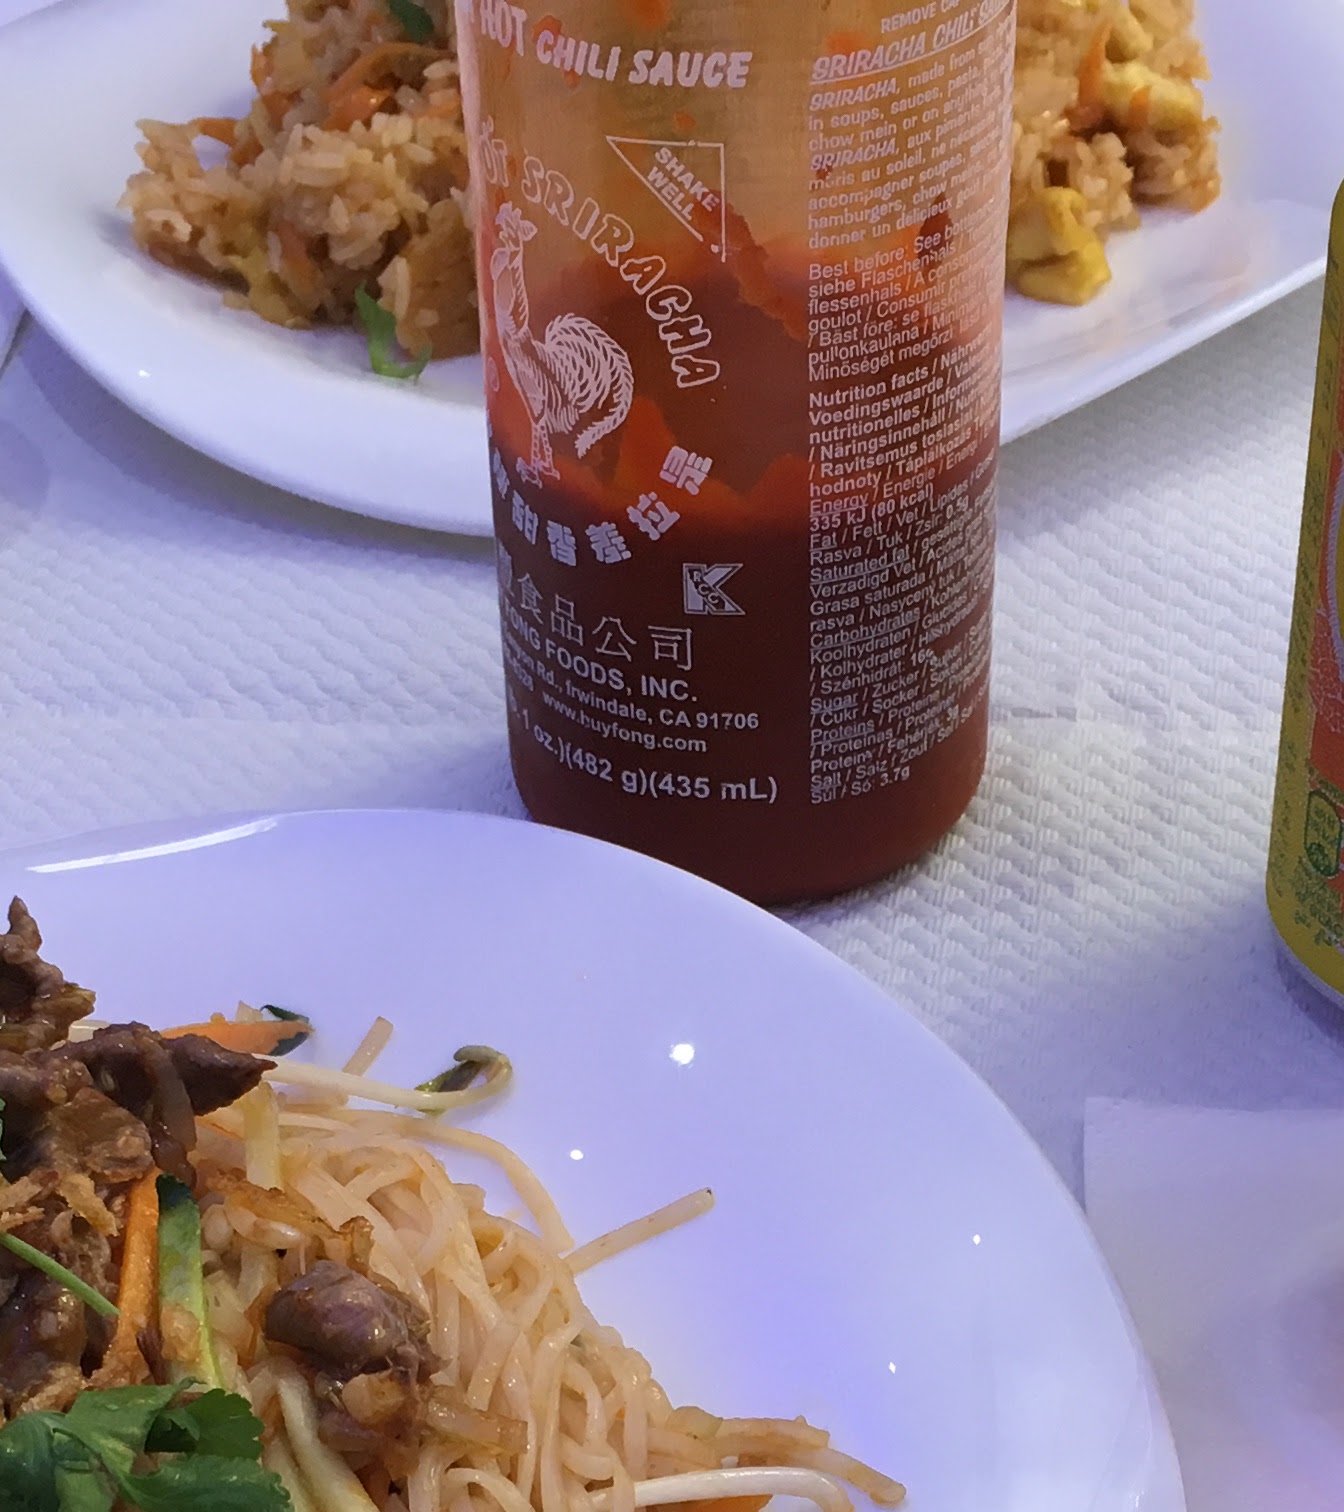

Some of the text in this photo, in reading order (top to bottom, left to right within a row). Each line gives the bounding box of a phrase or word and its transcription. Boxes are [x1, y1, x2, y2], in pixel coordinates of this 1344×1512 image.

[881, 2, 936, 32] REMOVE
[480, 0, 753, 88] HOT CHILI SAUCE
[812, 33, 925, 79] SRIRACHA
[810, 78, 900, 110] SRIRACHA,
[908, 65, 944, 87] made
[950, 49, 974, 70] from
[809, 117, 823, 130] in
[831, 108, 884, 127] soups,
[891, 88, 942, 113] sauces,
[809, 133, 853, 150] chow
[860, 122, 896, 141] mein
[903, 116, 917, 129] or
[922, 108, 938, 122] on
[811, 138, 899, 170] SRIRACHA,
[907, 129, 930, 147] aux
[861, 167, 879, 181] au
[886, 148, 926, 174] soleil,
[931, 142, 946, 158] ne
[647, 165, 696, 221] WELL
[654, 146, 721, 213] SHAKE
[809, 176, 914, 209] accompagner
[919, 153, 965, 181] soupes,
[808, 200, 905, 229] hamburgers,
[913, 181, 947, 203] chow
[808, 229, 866, 248] donner
[872, 223, 890, 237] un
[809, 260, 848, 279] Best
[854, 245, 908, 271] before:
[914, 232, 941, 252] See
[522, 155, 720, 389] SRIRACHA
[808, 279, 855, 297] siehe
[861, 242, 955, 285] Flaschenhals
[808, 282, 901, 313] flessenhals
[914, 272, 925, 287] A
[808, 310, 861, 333] goulot
[876, 281, 945, 316] Consumir
[820, 327, 857, 345] Bäst
[863, 318, 897, 337] före:
[902, 310, 919, 325] se
[809, 382, 885, 407] Nutrition
[891, 366, 928, 389] facts
[809, 378, 943, 424] Voedingswaarde
[809, 406, 919, 443] nutritionelles
[820, 409, 945, 458] Näringsinnehåll
[820, 442, 917, 476] Ravitsemus
[810, 472, 881, 496] hodnoty
[810, 493, 868, 515] Energy
[883, 468, 935, 497] Energie
[810, 483, 933, 531] 335 kJ (80 kcal)
[809, 532, 836, 550] Fat
[852, 520, 882, 540] Fett
[896, 507, 917, 525] Vet
[809, 546, 861, 564] Rasva
[877, 531, 902, 549] Tuk
[810, 552, 887, 583] Saturated
[892, 544, 909, 563] fat
[810, 569, 889, 597] Verzadigd
[893, 558, 916, 576] Vet
[810, 596, 859, 615] Grasa
[865, 572, 925, 602] saturada
[810, 614, 854, 631] rasva
[810, 608, 920, 648] Carbohydrates
[810, 628, 910, 663] Koolhydraten
[820, 645, 907, 677] Kolhydrater
[546, 638, 631, 696] FOODS,
[641, 675, 697, 702] INC.
[810, 693, 858, 714] Sugar
[872, 670, 919, 696] Zucker
[820, 708, 858, 725] Cukr
[871, 685, 919, 712] Socker
[660, 709, 691, 728] CA
[696, 712, 760, 730] 91706
[810, 720, 873, 745] Proteins
[810, 772, 841, 790] Salt
[855, 760, 887, 778] Salz
[900, 738, 927, 762] Zout
[879, 766, 910, 786] 3.7g
[721, 776, 778, 804] mL)
